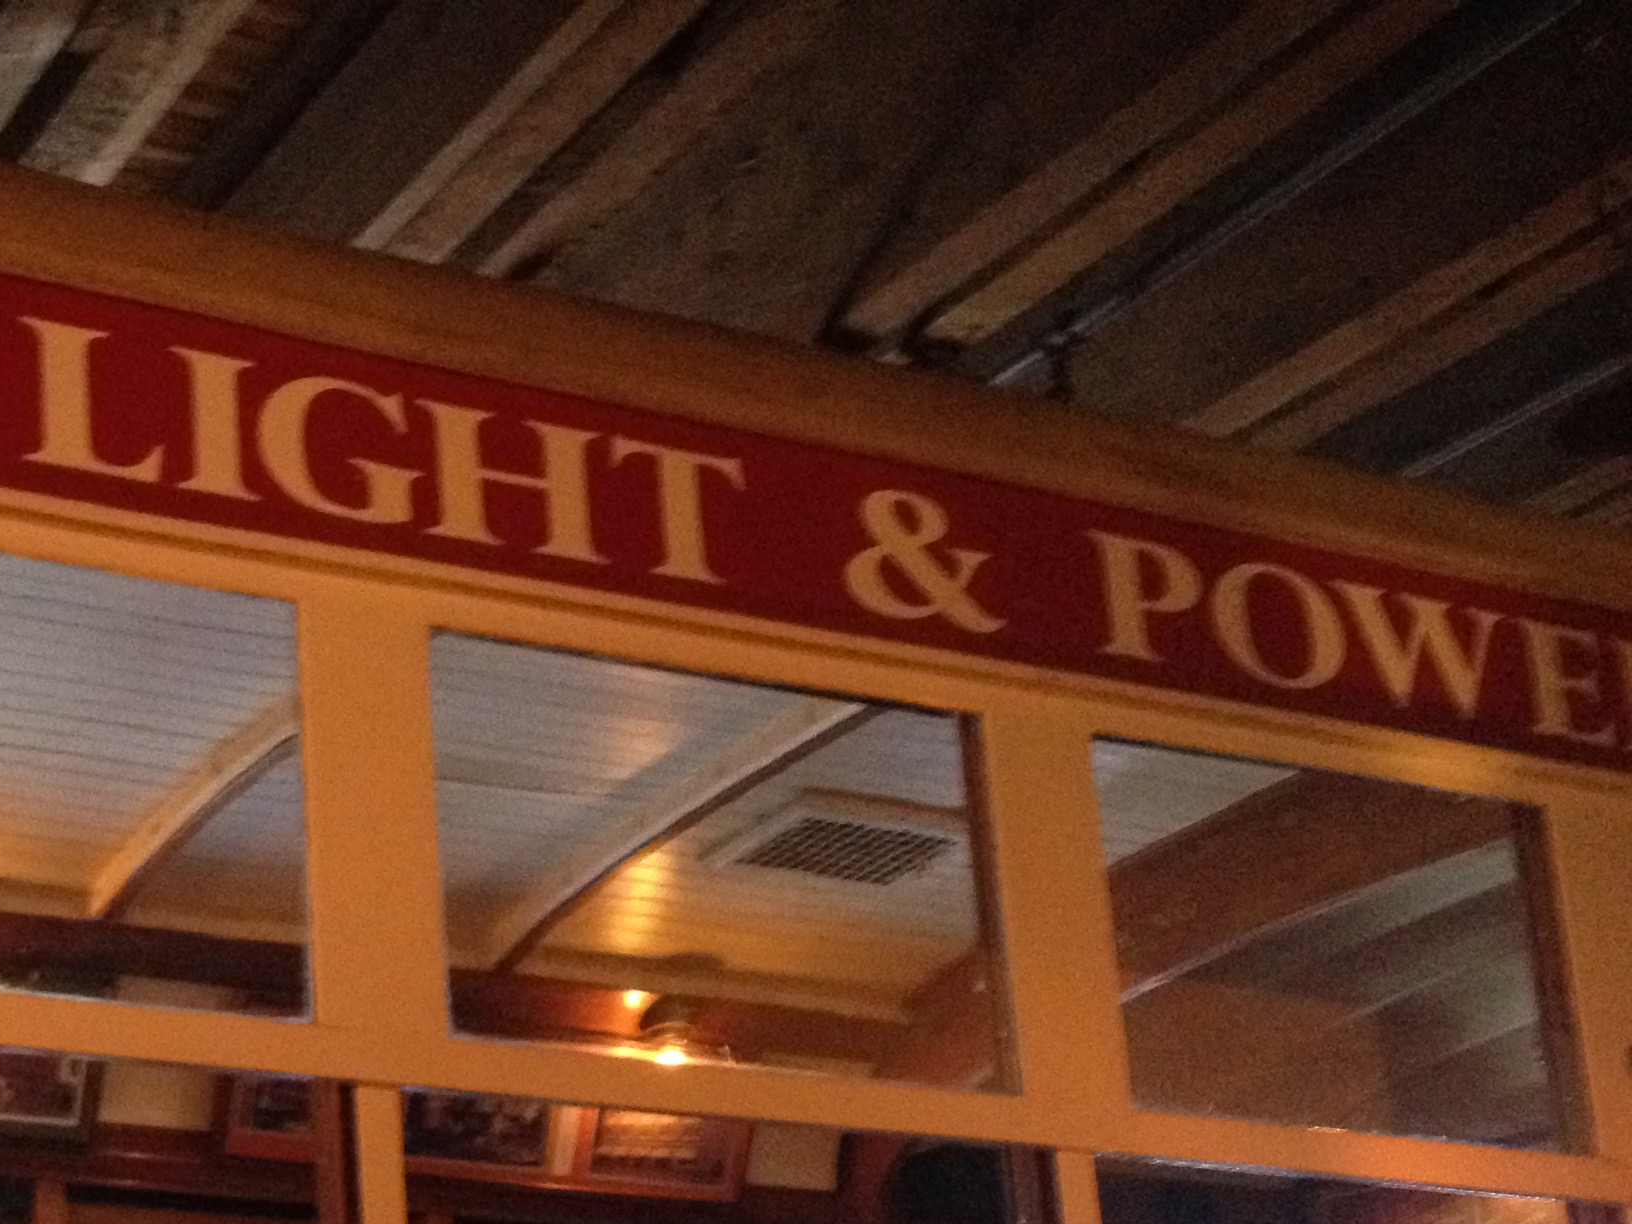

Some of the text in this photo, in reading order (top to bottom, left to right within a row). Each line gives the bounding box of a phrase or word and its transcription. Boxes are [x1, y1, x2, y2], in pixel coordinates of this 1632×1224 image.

[17, 314, 747, 586] LIGHT
[843, 488, 1009, 635] &
[1084, 528, 1632, 751] POWE
